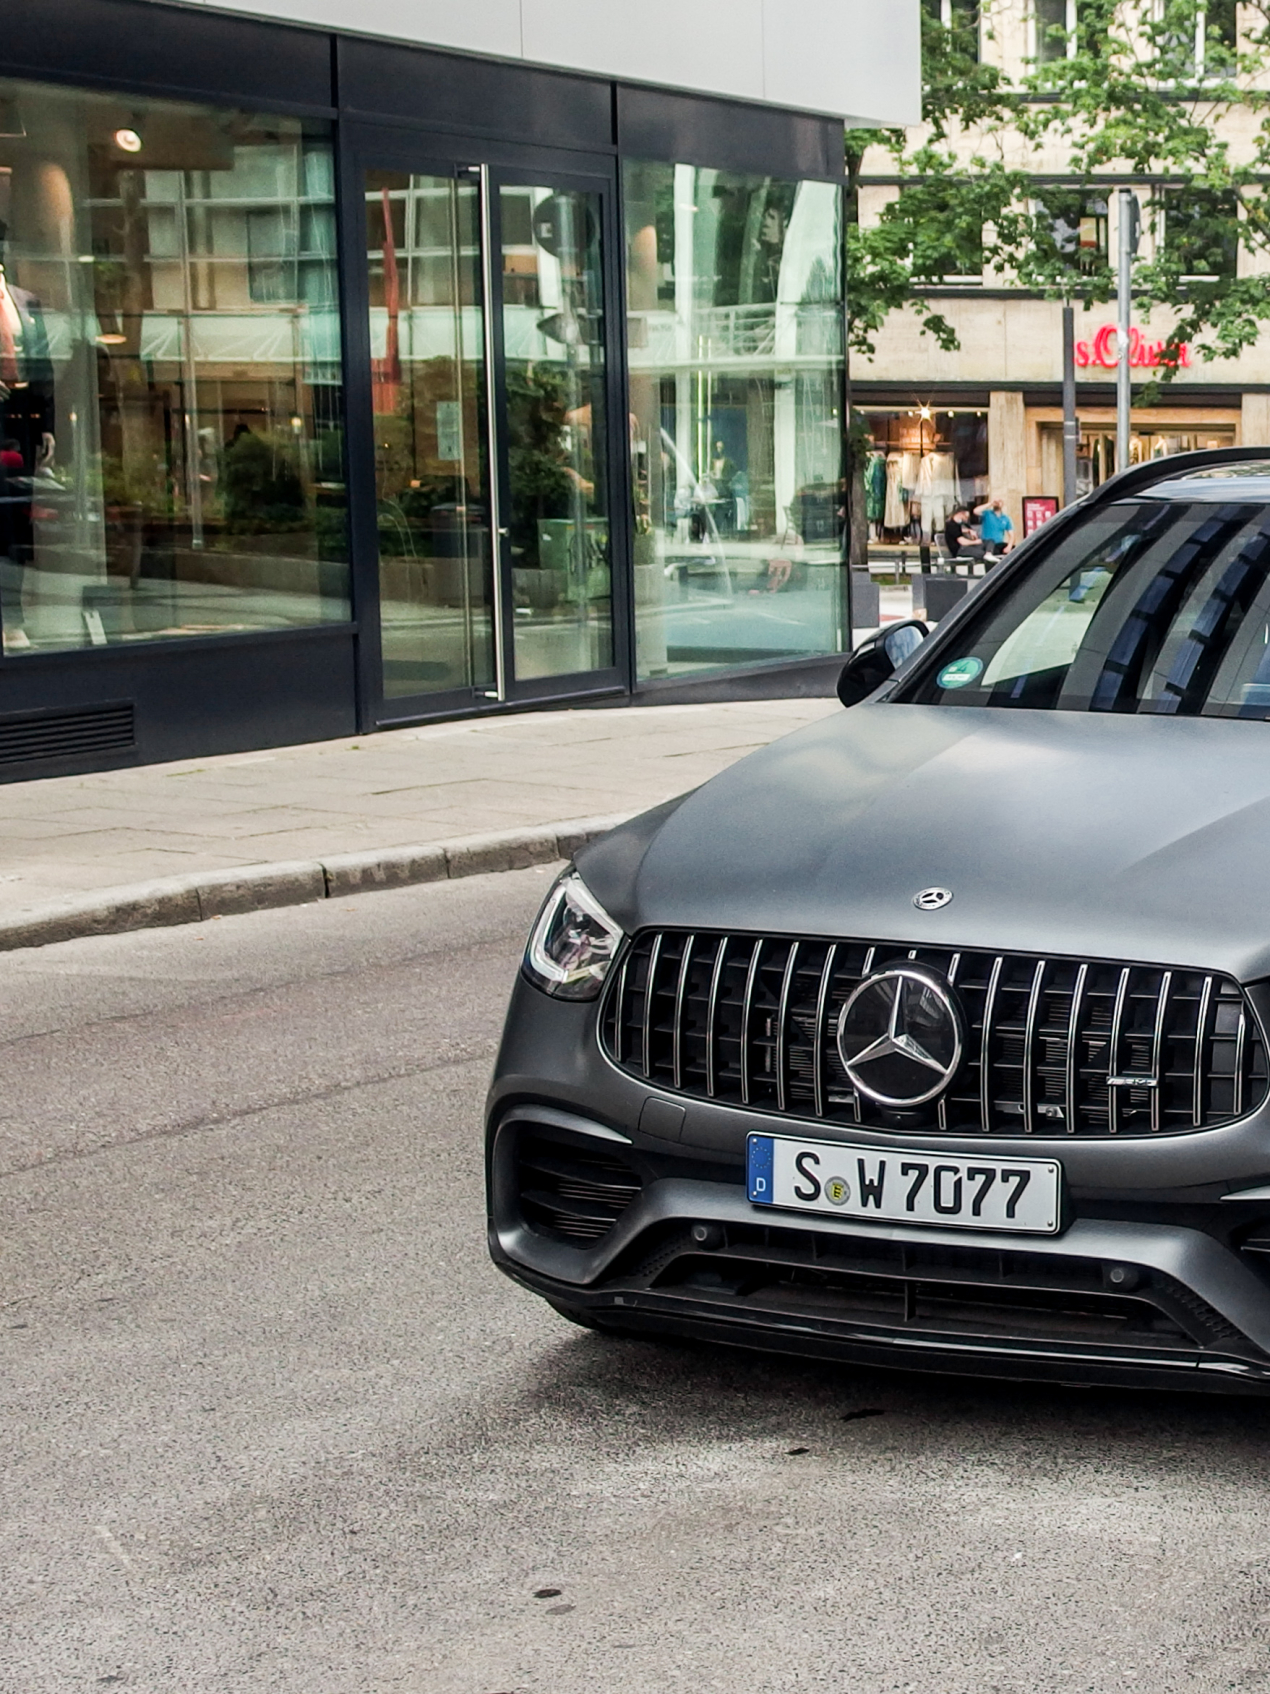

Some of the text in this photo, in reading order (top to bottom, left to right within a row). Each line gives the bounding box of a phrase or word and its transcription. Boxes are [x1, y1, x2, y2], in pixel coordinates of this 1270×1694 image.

[756, 1177, 767, 1193] D
[794, 1151, 1031, 1218] S W 7077
